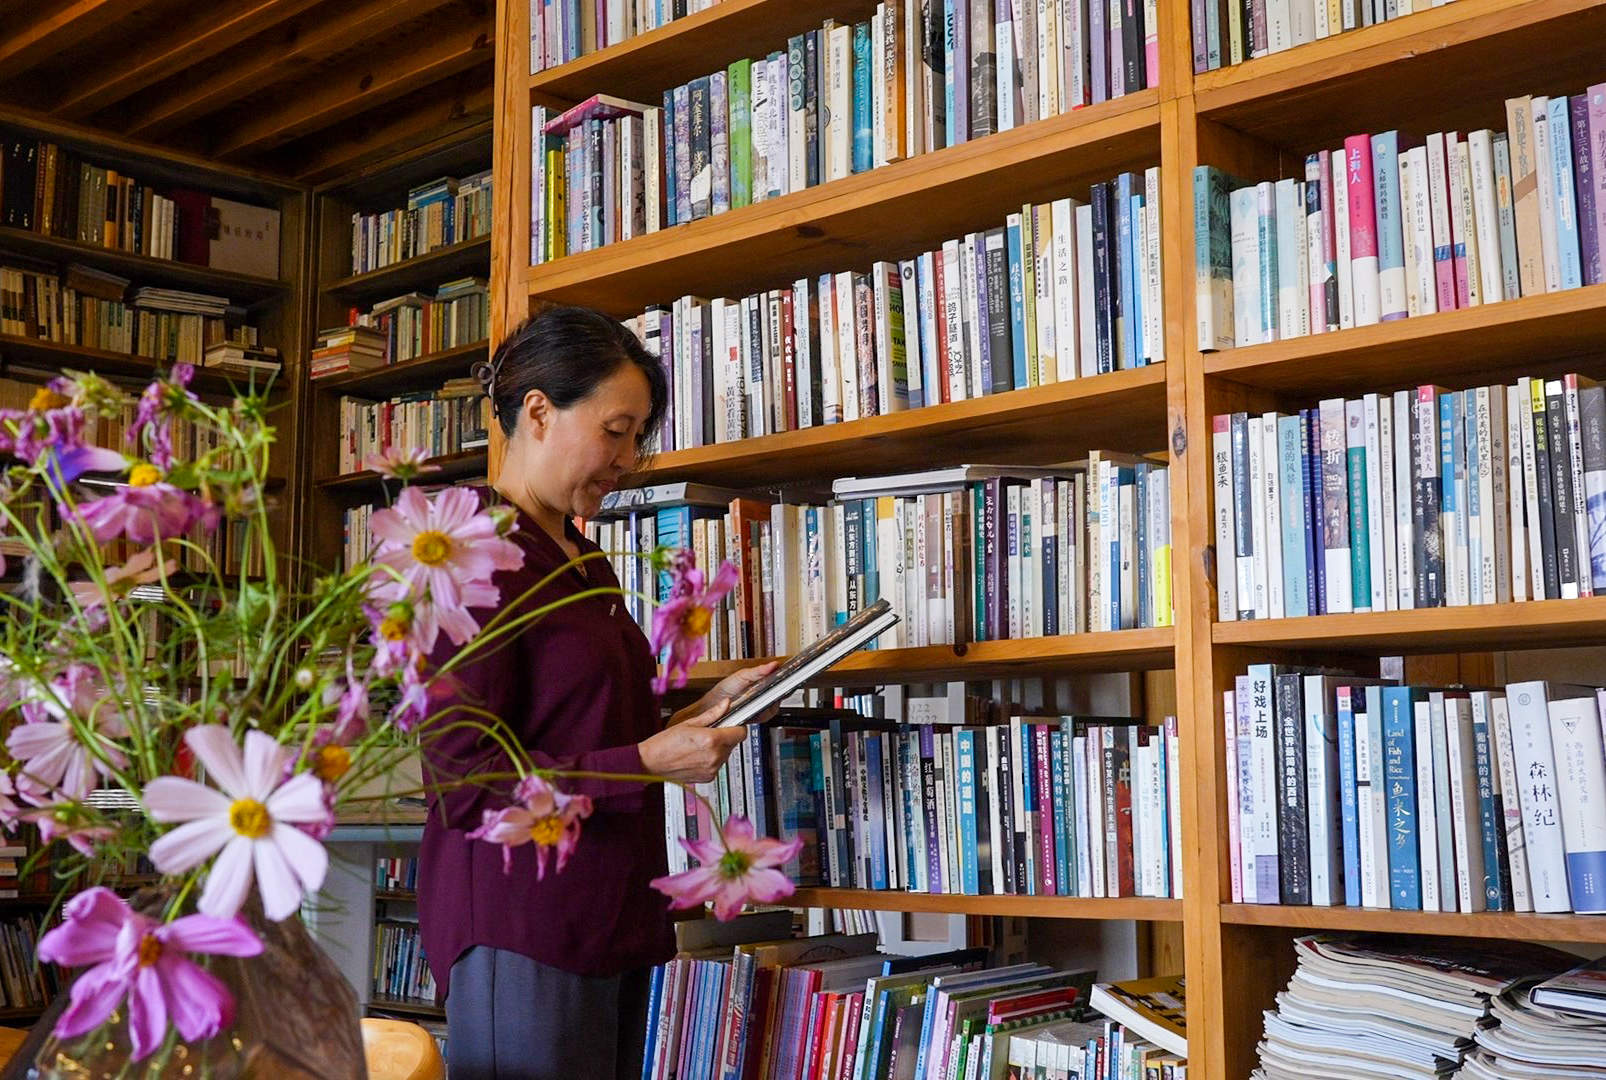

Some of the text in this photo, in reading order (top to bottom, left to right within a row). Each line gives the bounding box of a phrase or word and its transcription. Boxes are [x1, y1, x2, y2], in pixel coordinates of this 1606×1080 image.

[1350, 149, 1361, 184] 上海人
[1576, 120, 1589, 173] 第十三个故事
[1058, 234, 1068, 285] 生活之路
[955, 351, 963, 374] JOHN
[1253, 680, 1268, 739] 好戏上场
[1388, 729, 1404, 738] Land
[1053, 739, 1062, 806] 中国人的特性
[1388, 747, 1402, 756] Fish
[1389, 757, 1401, 765] and
[1389, 765, 1403, 774] Rice
[1477, 732, 1491, 798] 葡萄酒的奥秘
[1391, 781, 1410, 849] 鱼米之乡
[1529, 761, 1555, 826] 森林纪
